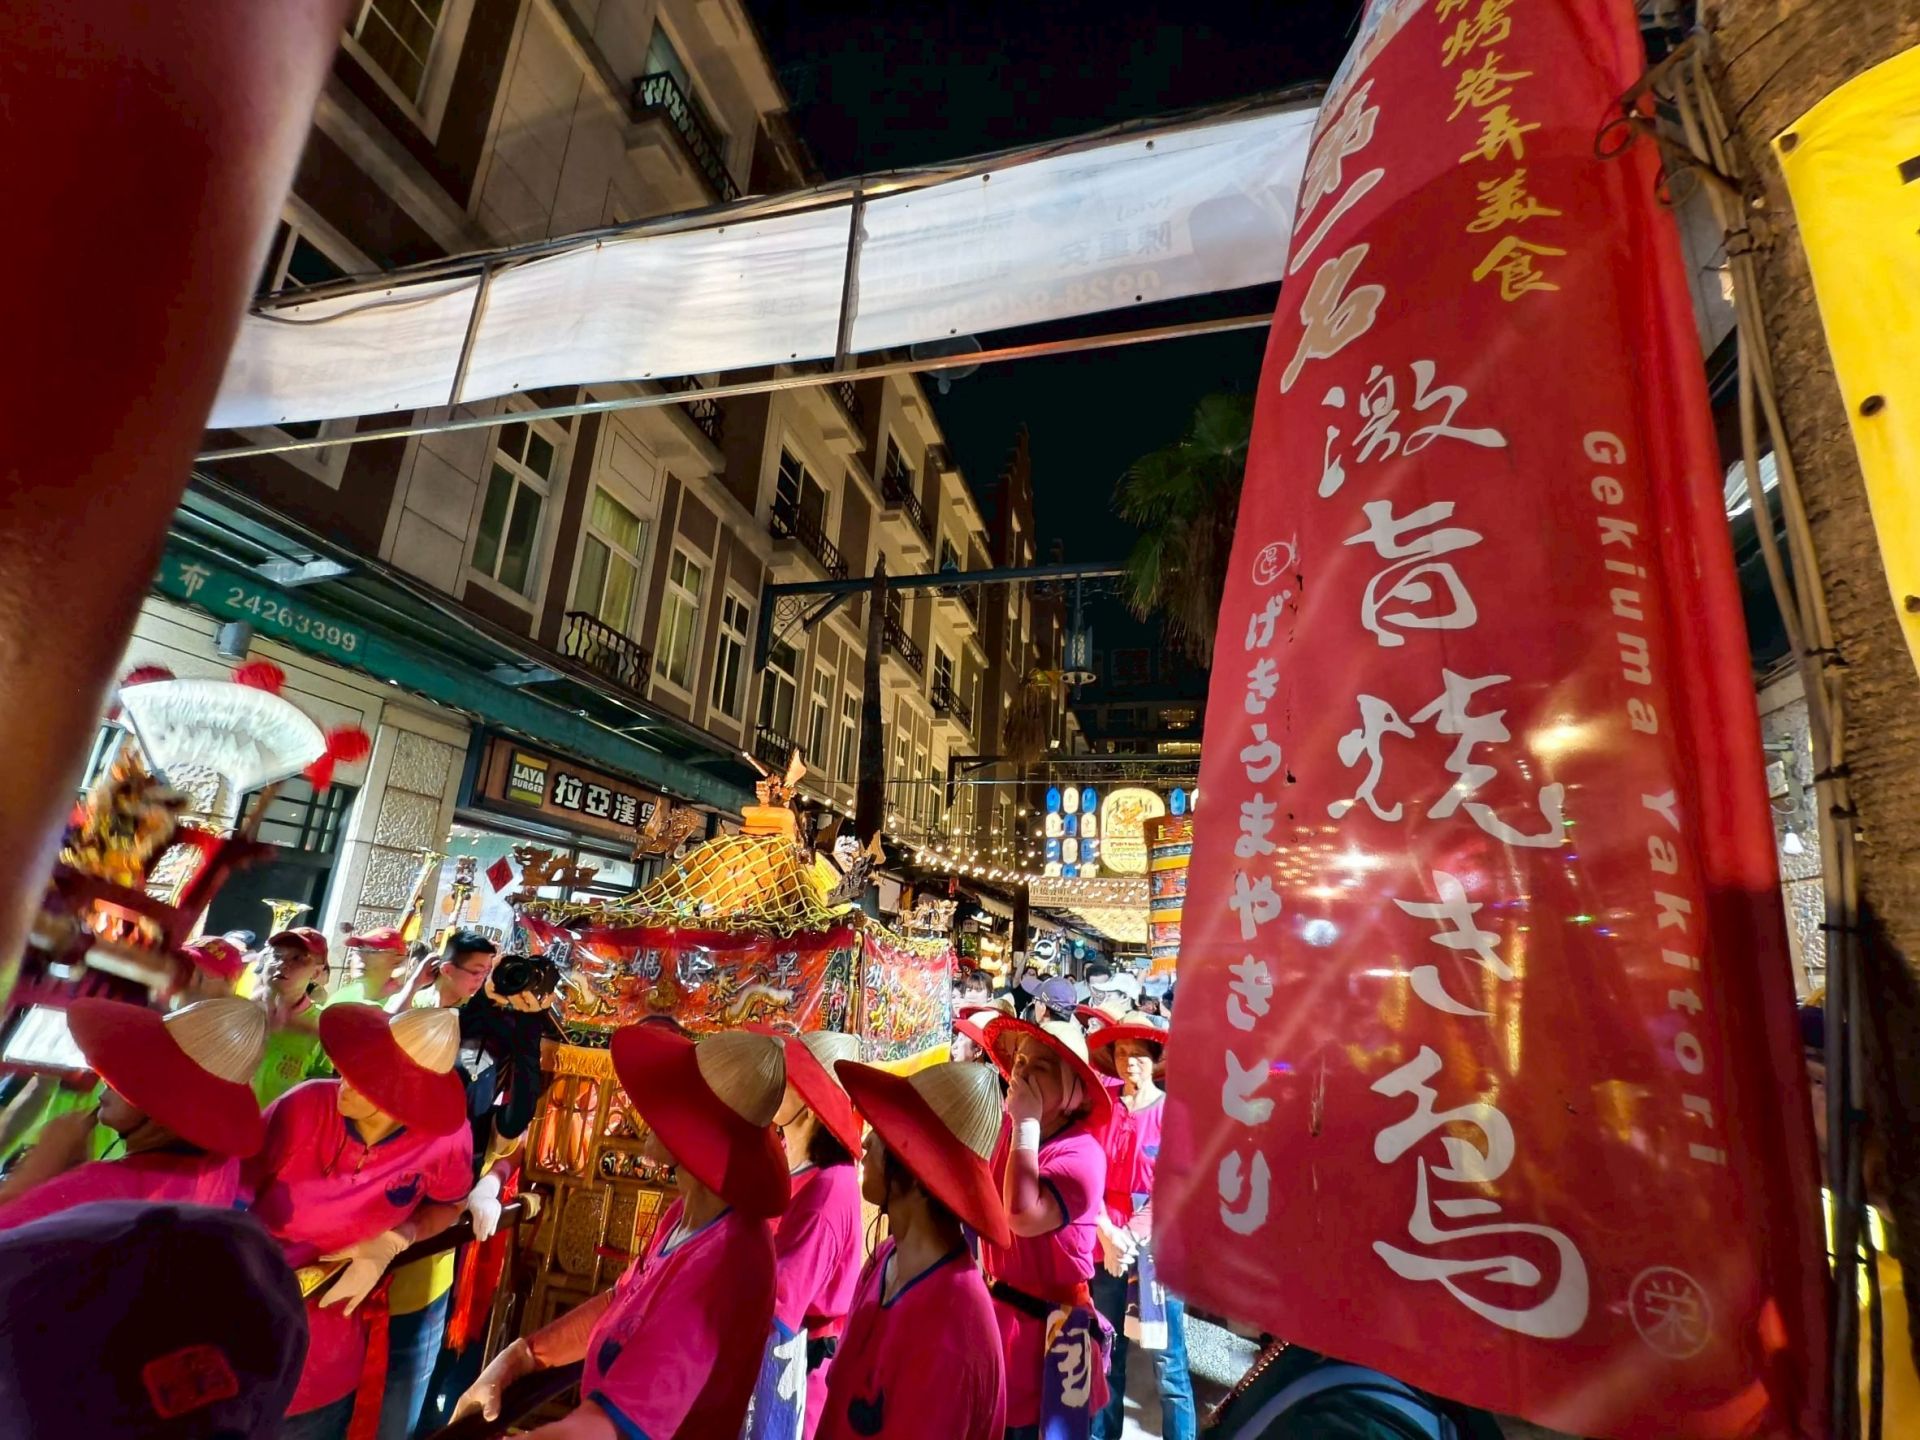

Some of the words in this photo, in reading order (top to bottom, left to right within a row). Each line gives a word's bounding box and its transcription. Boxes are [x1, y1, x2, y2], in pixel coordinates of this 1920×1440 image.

[1435, 0, 1566, 301] 烤巷弄美食
[226, 587, 356, 652] 24263399
[512, 777, 544, 794] BURGER
[513, 764, 545, 785] LAYA
[1582, 430, 1658, 735] Gekiuma
[1641, 788, 1725, 1167] Yakitori
[1218, 590, 1292, 1236] げきうまやきとり
